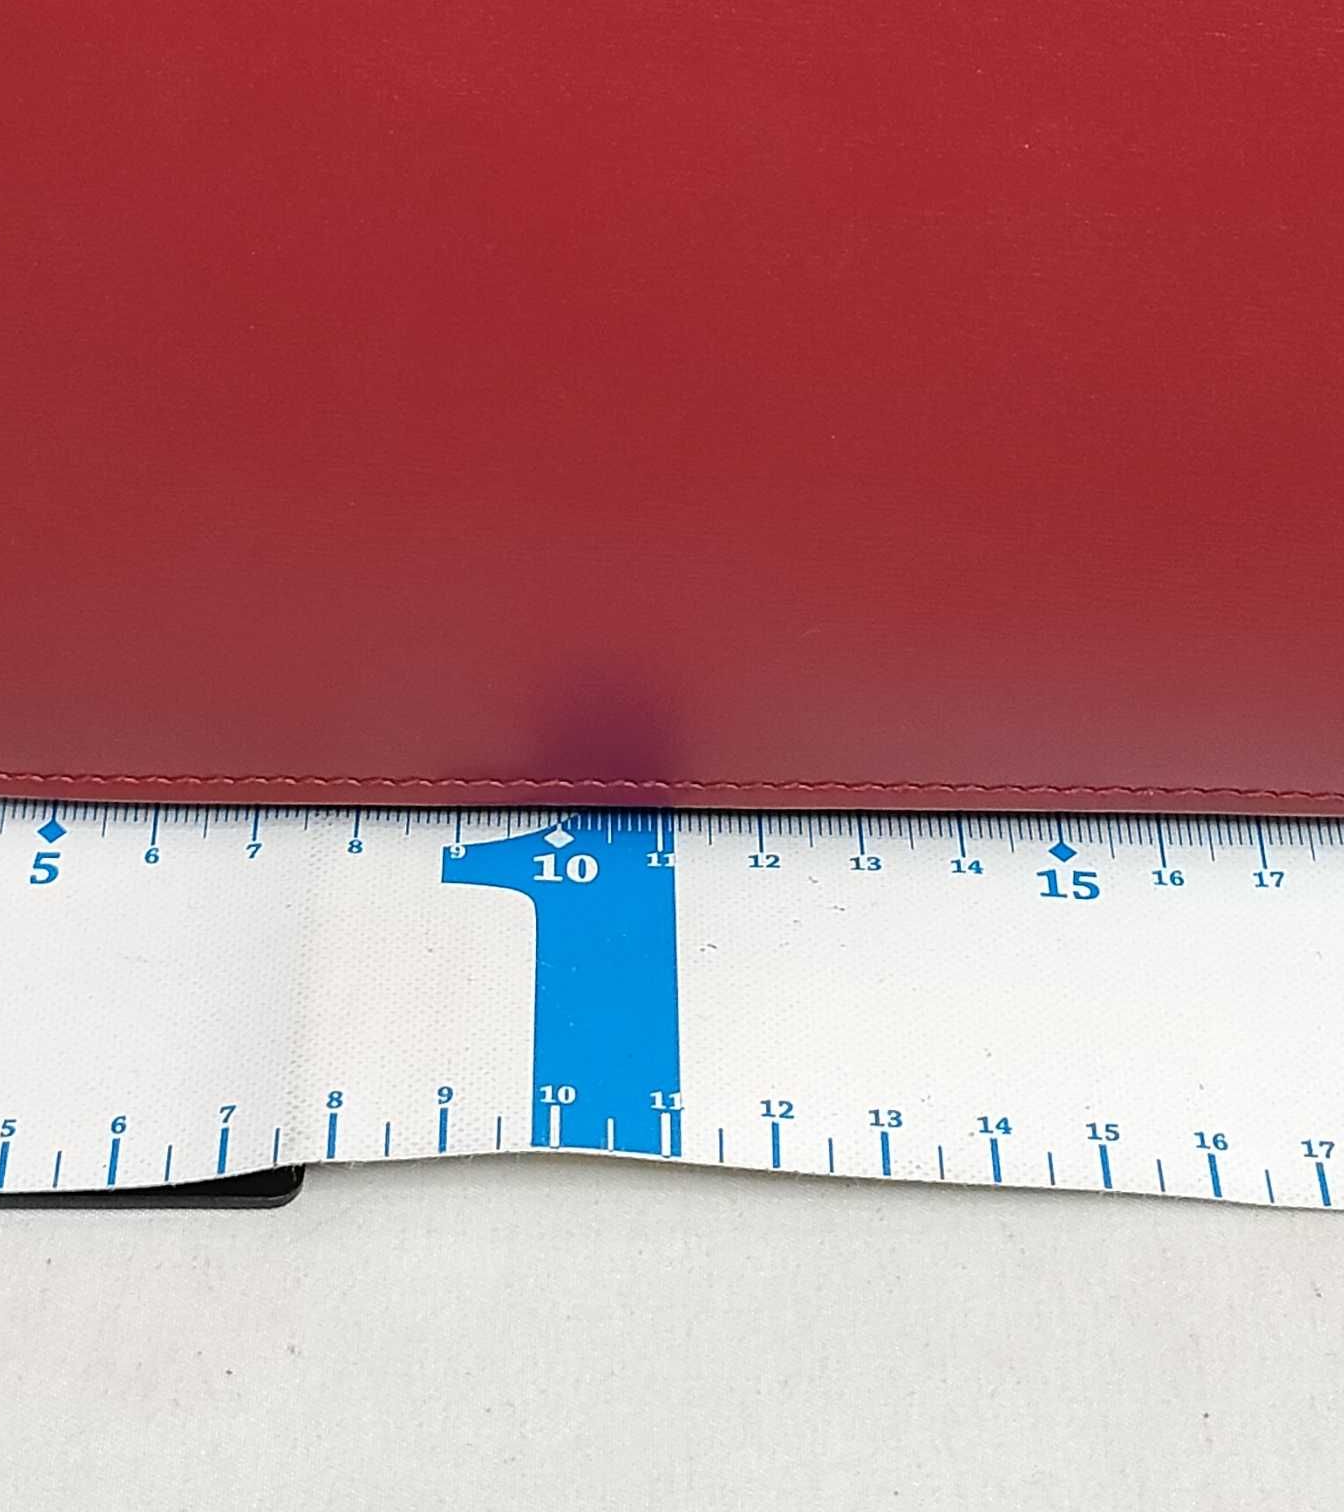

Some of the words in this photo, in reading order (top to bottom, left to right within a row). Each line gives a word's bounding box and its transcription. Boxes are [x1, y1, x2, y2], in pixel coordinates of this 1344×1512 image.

[29, 852, 61, 885] 5
[144, 847, 160, 865] 6
[247, 843, 262, 859] 7
[347, 839, 363, 855] 8
[449, 844, 466, 860] 9
[534, 854, 598, 883] 10
[646, 853, 675, 868] 11
[749, 855, 781, 869] 12
[849, 856, 882, 872] 13
[951, 859, 984, 875] 14
[1037, 869, 1101, 900] 15
[1152, 871, 1185, 886] 16
[1253, 871, 1285, 888] 17
[442, 806, 681, 1156] 1
[0, 1120, 16, 1137] 5
[111, 1116, 127, 1133] 6
[220, 1106, 236, 1123] 7
[326, 1091, 342, 1108] 8
[437, 1087, 453, 1103] 9
[540, 1087, 576, 1103] 10
[651, 1093, 683, 1110] 11
[760, 1101, 794, 1120] 12
[869, 1110, 903, 1127] 13
[978, 1118, 1012, 1135] 14
[1086, 1124, 1120, 1141] 15
[1194, 1132, 1228, 1151] 16
[1301, 1141, 1334, 1158] 17
